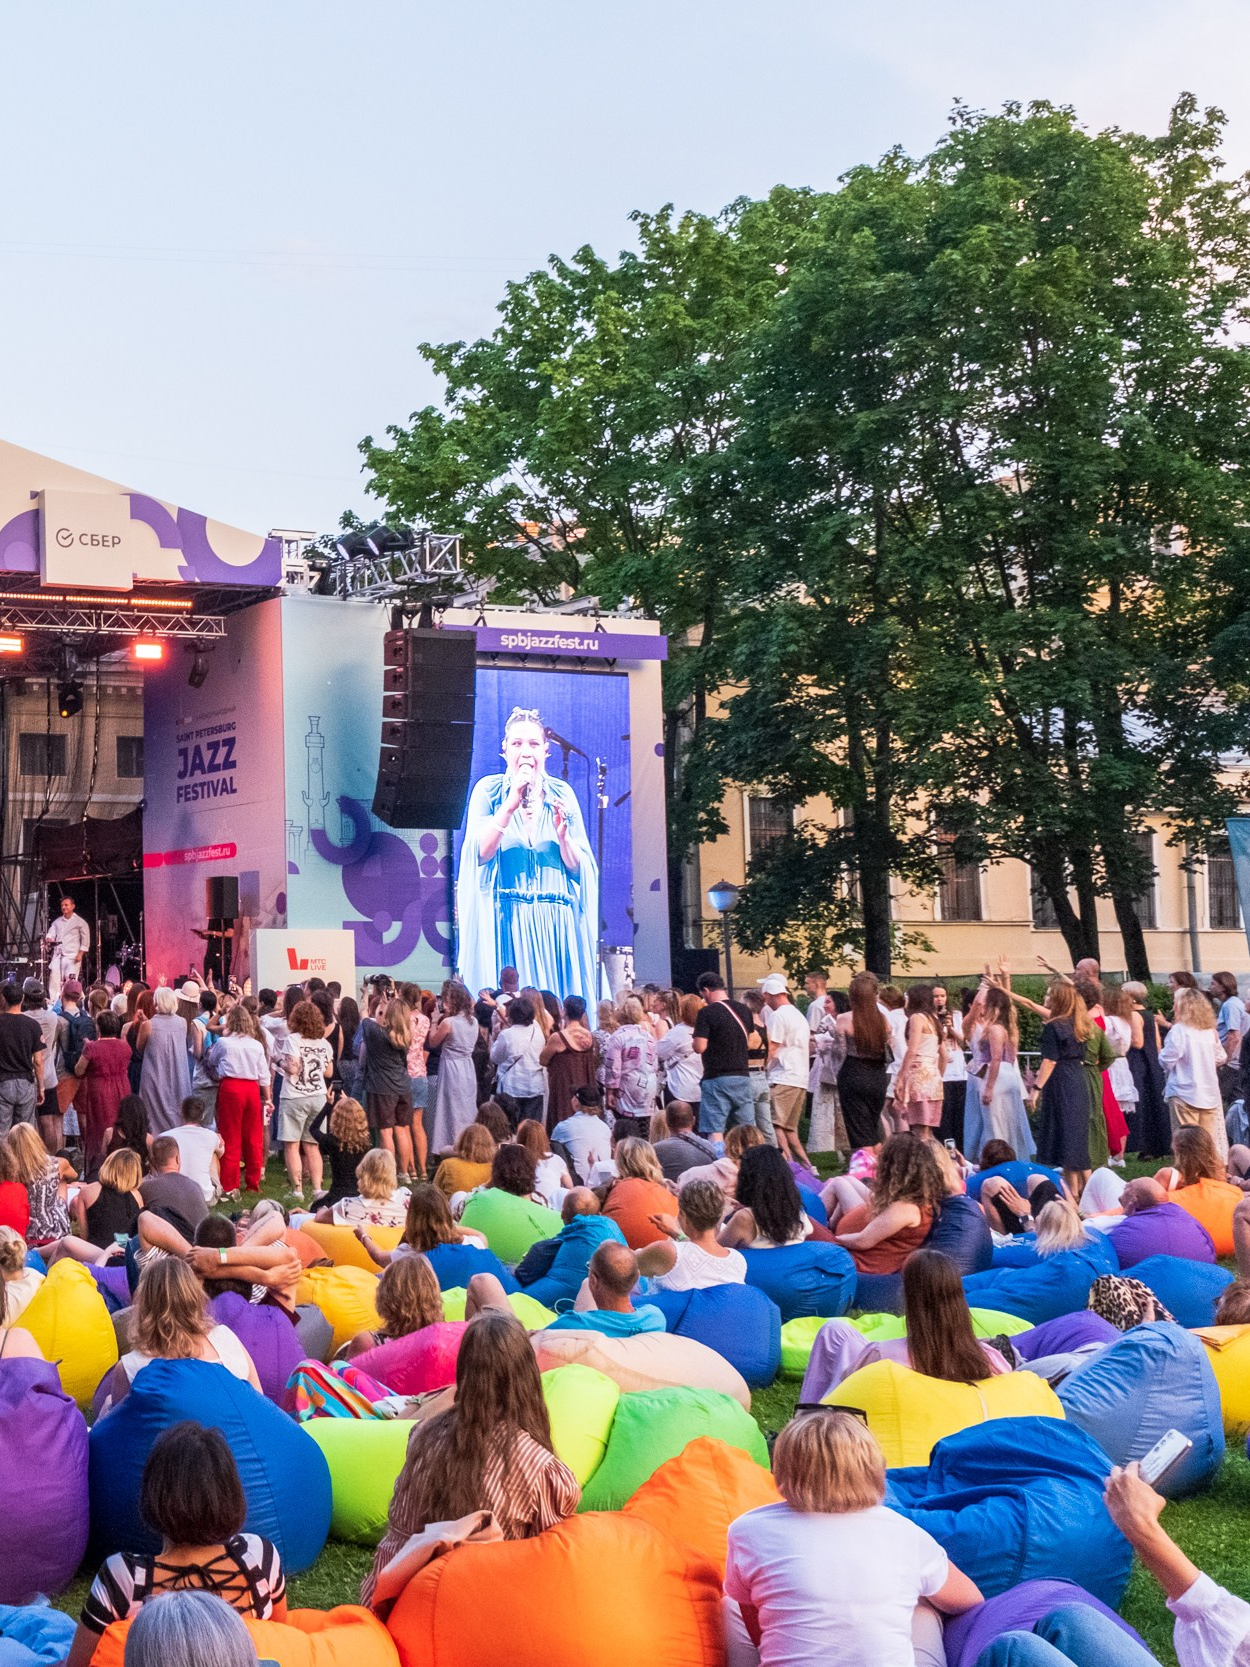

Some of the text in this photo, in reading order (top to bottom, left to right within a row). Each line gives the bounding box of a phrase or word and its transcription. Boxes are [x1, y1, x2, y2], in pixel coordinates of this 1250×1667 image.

[78, 533, 122, 548] СБЕР
[500, 632, 599, 650] spbjazzfest.ru
[176, 721, 237, 743] SAINT PETERSBURG
[177, 736, 237, 780] JAZZ
[176, 776, 238, 804] FESTIVAL
[184, 845, 231, 862] spbjazzfest.ru
